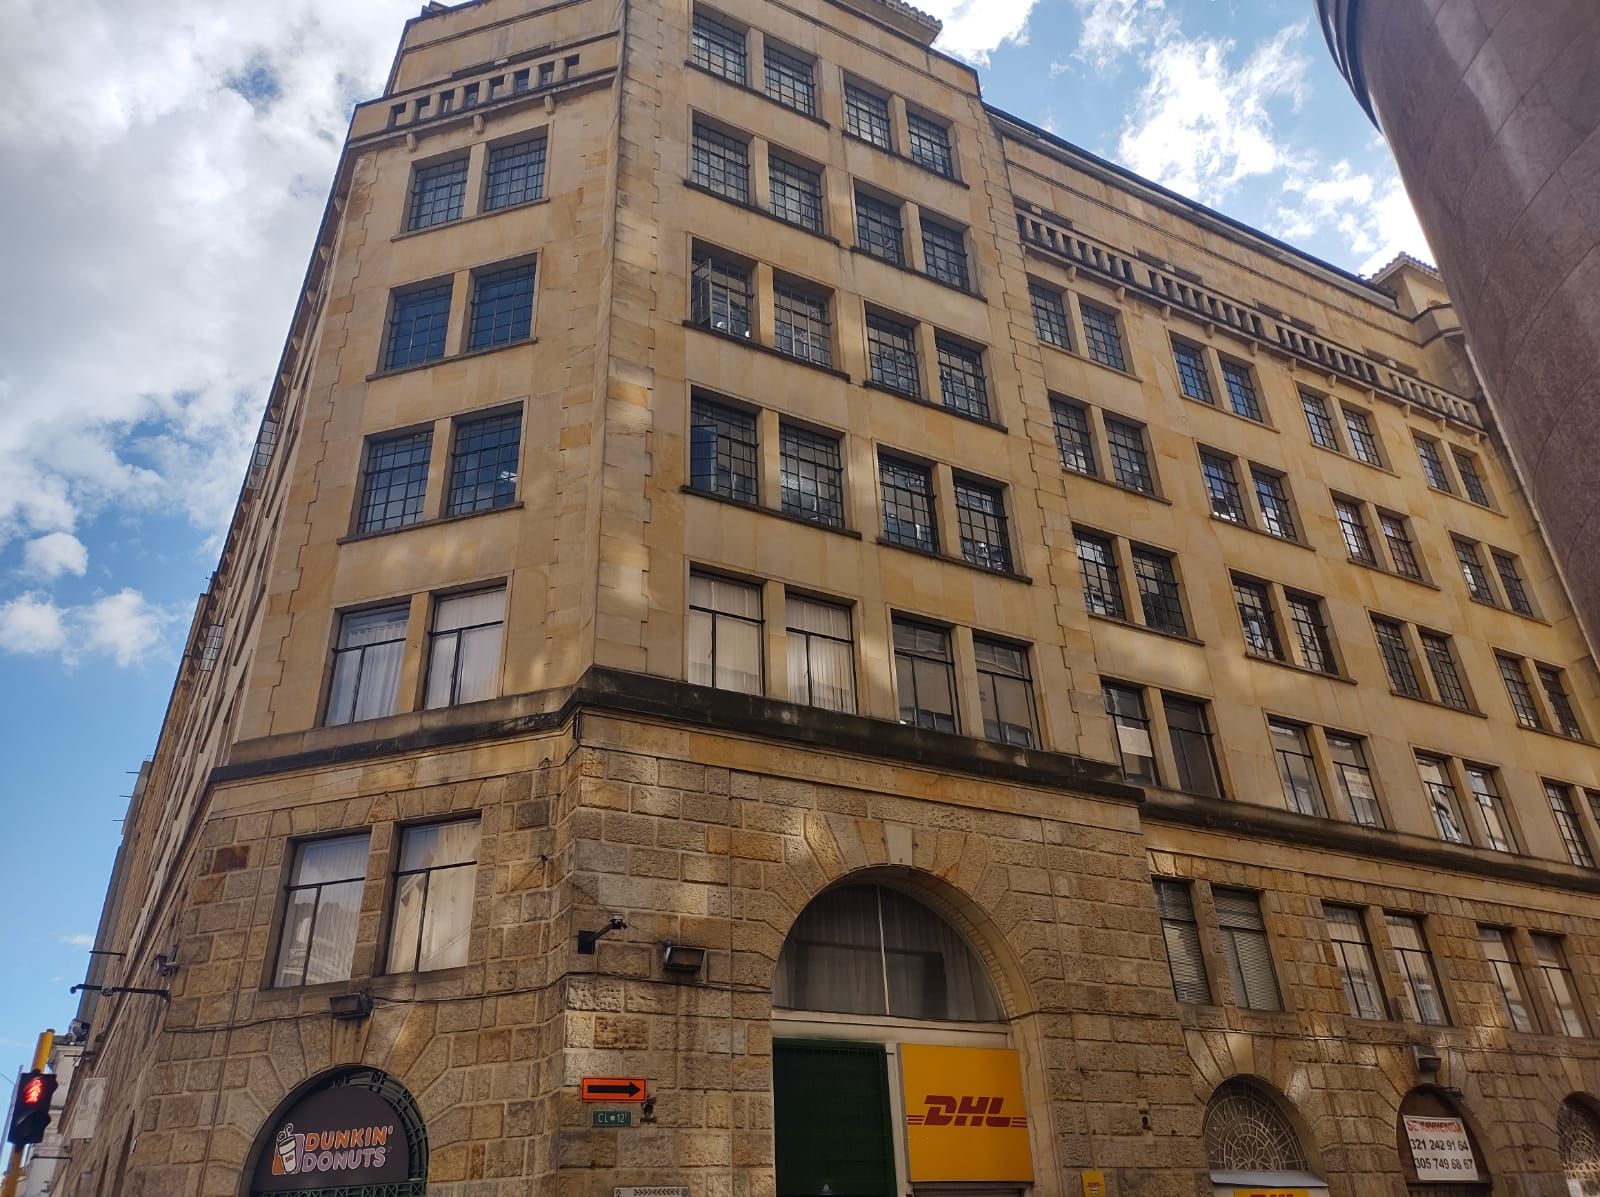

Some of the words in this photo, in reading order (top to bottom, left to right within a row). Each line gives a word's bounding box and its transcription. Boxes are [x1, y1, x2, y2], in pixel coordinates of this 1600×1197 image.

[598, 1113, 609, 1123] CL
[924, 1094, 1011, 1128] DHL
[304, 1125, 394, 1152] DUNKIN'
[1410, 1139, 1427, 1150] 321
[1429, 1139, 1445, 1151] 242
[1457, 1140, 1469, 1151] 64
[301, 1146, 386, 1173] DONUTS
[1414, 1157, 1431, 1169] 305
[1432, 1157, 1449, 1169] 749
[1451, 1158, 1462, 1169] 68
[1463, 1158, 1473, 1169] 67
